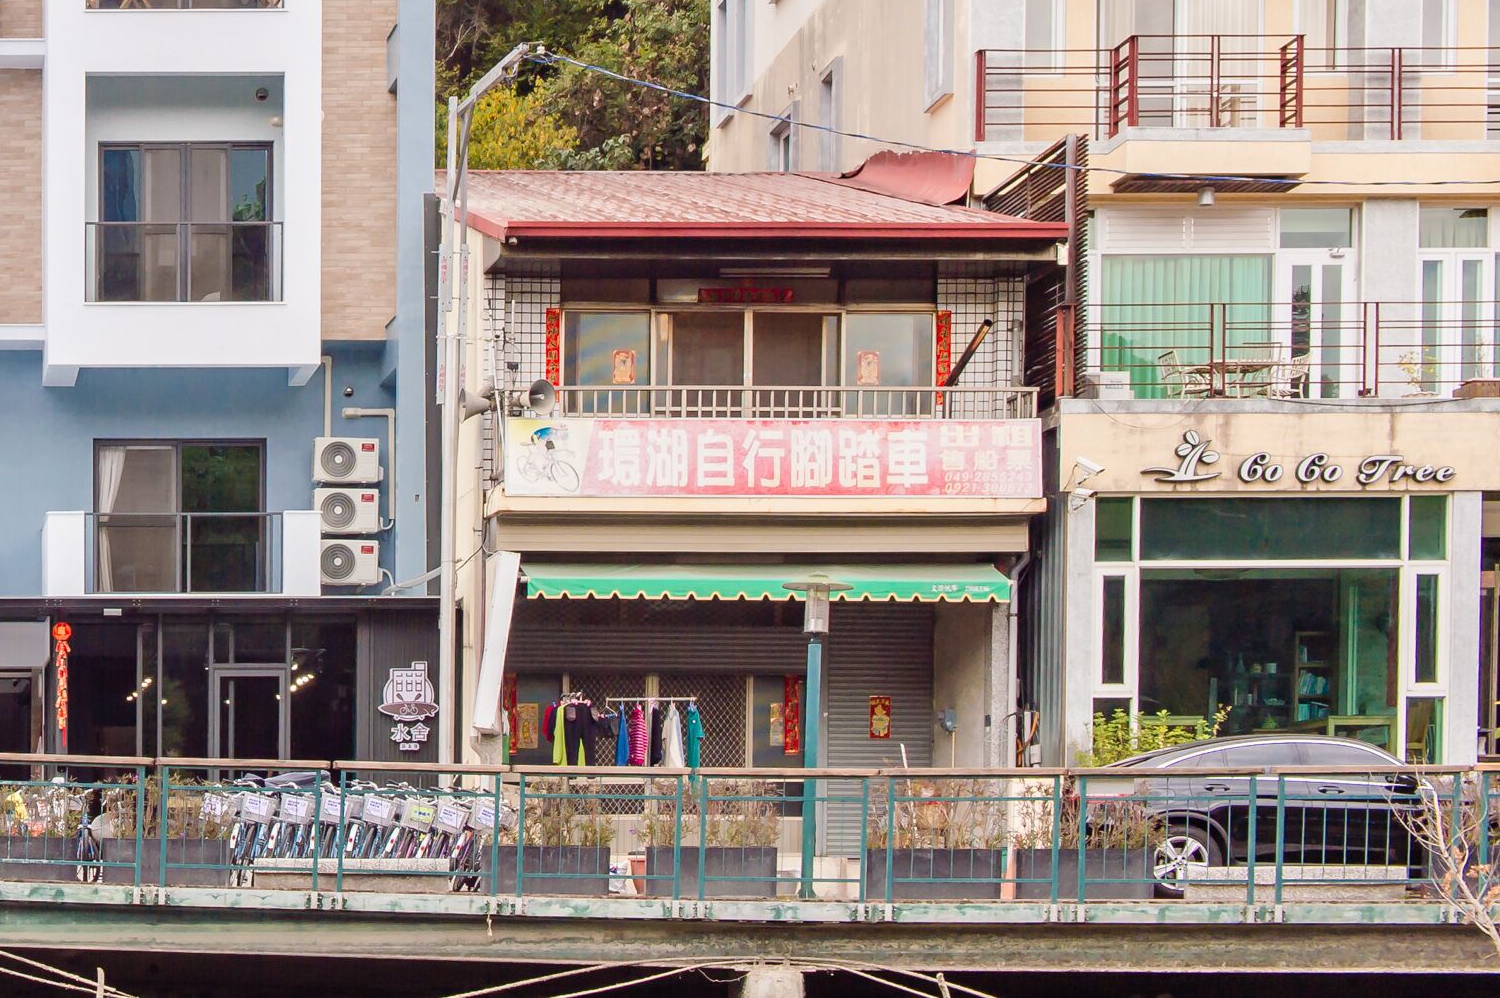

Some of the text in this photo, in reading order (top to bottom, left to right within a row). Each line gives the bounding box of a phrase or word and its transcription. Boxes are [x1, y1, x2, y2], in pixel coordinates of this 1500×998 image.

[940, 425, 1032, 446] 出租
[596, 428, 930, 489] 環湖自行腳踏車
[1356, 454, 1457, 484] Tree
[390, 722, 430, 742] 水舍
